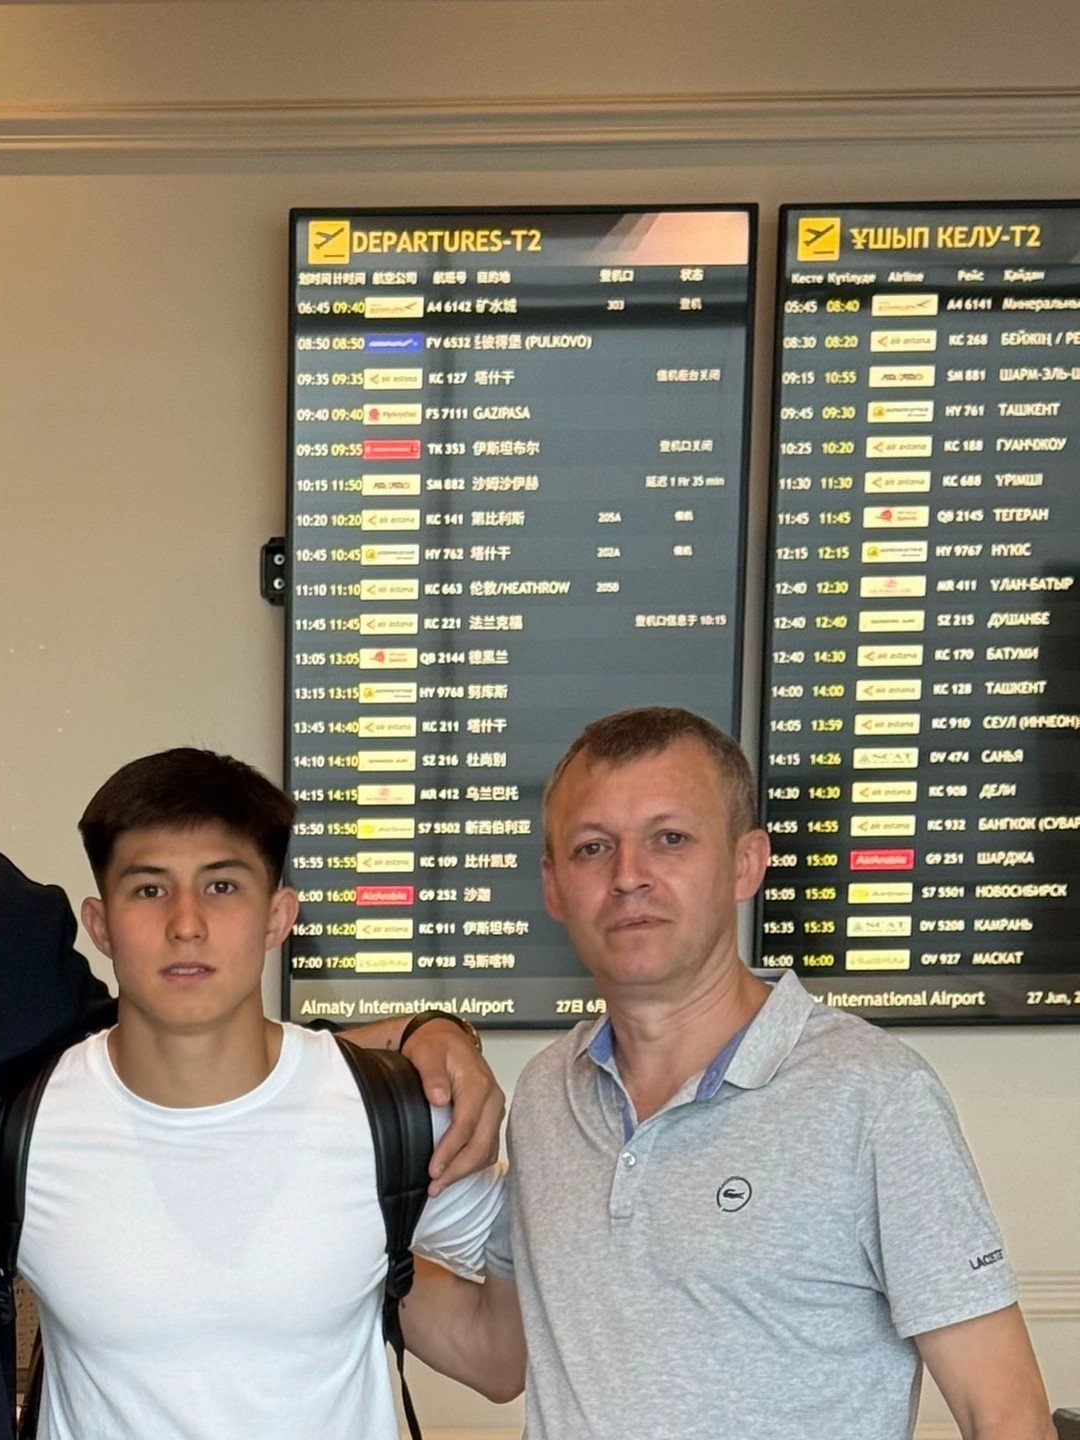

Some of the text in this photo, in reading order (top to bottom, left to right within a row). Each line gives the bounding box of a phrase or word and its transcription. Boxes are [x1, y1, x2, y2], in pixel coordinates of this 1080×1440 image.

[352, 230, 542, 253] DEPARTURES-T2
[849, 227, 929, 249] ҰШЫП
[298, 300, 330, 314] 06:45
[333, 300, 364, 314] 09:40
[785, 301, 817, 313] 05:45
[297, 337, 330, 350] 08:50
[332, 337, 364, 350] 08:50
[525, 335, 592, 350] (PULKOVO)
[297, 373, 329, 386] 09:35
[332, 373, 364, 386] 09:35
[447, 372, 467, 384] 127
[782, 371, 856, 384] 09:15 10:55
[297, 406, 530, 421] 09:40 09:40 7111 GAZIPASA
[781, 403, 1060, 419] 09:45 09:30 ТАШКЕНТ
[296, 444, 328, 456] 09:55
[331, 444, 363, 456] 09:55
[781, 442, 812, 454] 10:25
[297, 479, 328, 492] 10:15
[332, 479, 362, 492] 11:50
[297, 514, 327, 527] 10:20
[332, 514, 362, 527] 10:20
[444, 513, 463, 525] 141
[778, 512, 809, 524] 11:45
[820, 511, 851, 524] 11:45
[296, 549, 327, 561] 10:45
[331, 549, 362, 561] 10:45
[777, 547, 849, 559] 12:15 12:15
[296, 584, 327, 596] 11:10
[331, 584, 361, 596] 11:10
[776, 582, 807, 594] 12:40
[296, 618, 326, 631] 11:45
[330, 618, 361, 631] 11:45
[442, 617, 461, 630] 221
[774, 612, 1050, 629] 12:40 12:40 ДУШАНБЕ
[295, 653, 325, 665] 13:05
[330, 653, 360, 665] 13:05
[773, 651, 804, 664] 12:40
[814, 650, 845, 663] 14:30
[295, 687, 325, 700] 13:15
[329, 687, 360, 700] 13:15
[772, 681, 1046, 698] 14:00 14:00 ТАШКЕНТ
[294, 721, 324, 734] 13:45
[329, 721, 359, 734] 14:40
[440, 720, 459, 732] 211
[771, 719, 801, 732] 14:05
[983, 716, 1016, 728] СЕУЛ
[294, 755, 324, 768] 14:10
[328, 755, 359, 768] 14:10
[770, 753, 800, 765] 14:15
[294, 789, 324, 801] 14:15
[328, 789, 359, 801] 14:15
[439, 788, 459, 800] 412
[769, 787, 799, 799] 14:30
[809, 786, 840, 799] 14:30
[294, 823, 358, 835] 15:50 15:50
[767, 821, 797, 833] 14:55
[808, 820, 838, 833] 14:55
[293, 856, 323, 869] 15:55
[328, 856, 358, 869] 15:55
[807, 854, 837, 866] 15:00
[298, 889, 357, 902] 6:00 16:00
[765, 888, 795, 900] 15:05
[806, 887, 836, 900] 15:05
[293, 923, 323, 935] 16:20
[327, 923, 357, 935] 16:20
[436, 922, 455, 934] 911
[764, 921, 794, 934] 15:35
[804, 921, 835, 933] 15:35
[292, 956, 322, 969] 17:00
[326, 956, 356, 969] 17:00
[763, 954, 793, 967] 16:00
[803, 954, 834, 967] 16:00
[827, 990, 927, 1006] International
[930, 989, 986, 1008] Airport
[1027, 991, 1043, 1004] 27
[301, 1000, 355, 1016] Almaty
[359, 998, 457, 1014] International
[460, 998, 515, 1016] Airport
